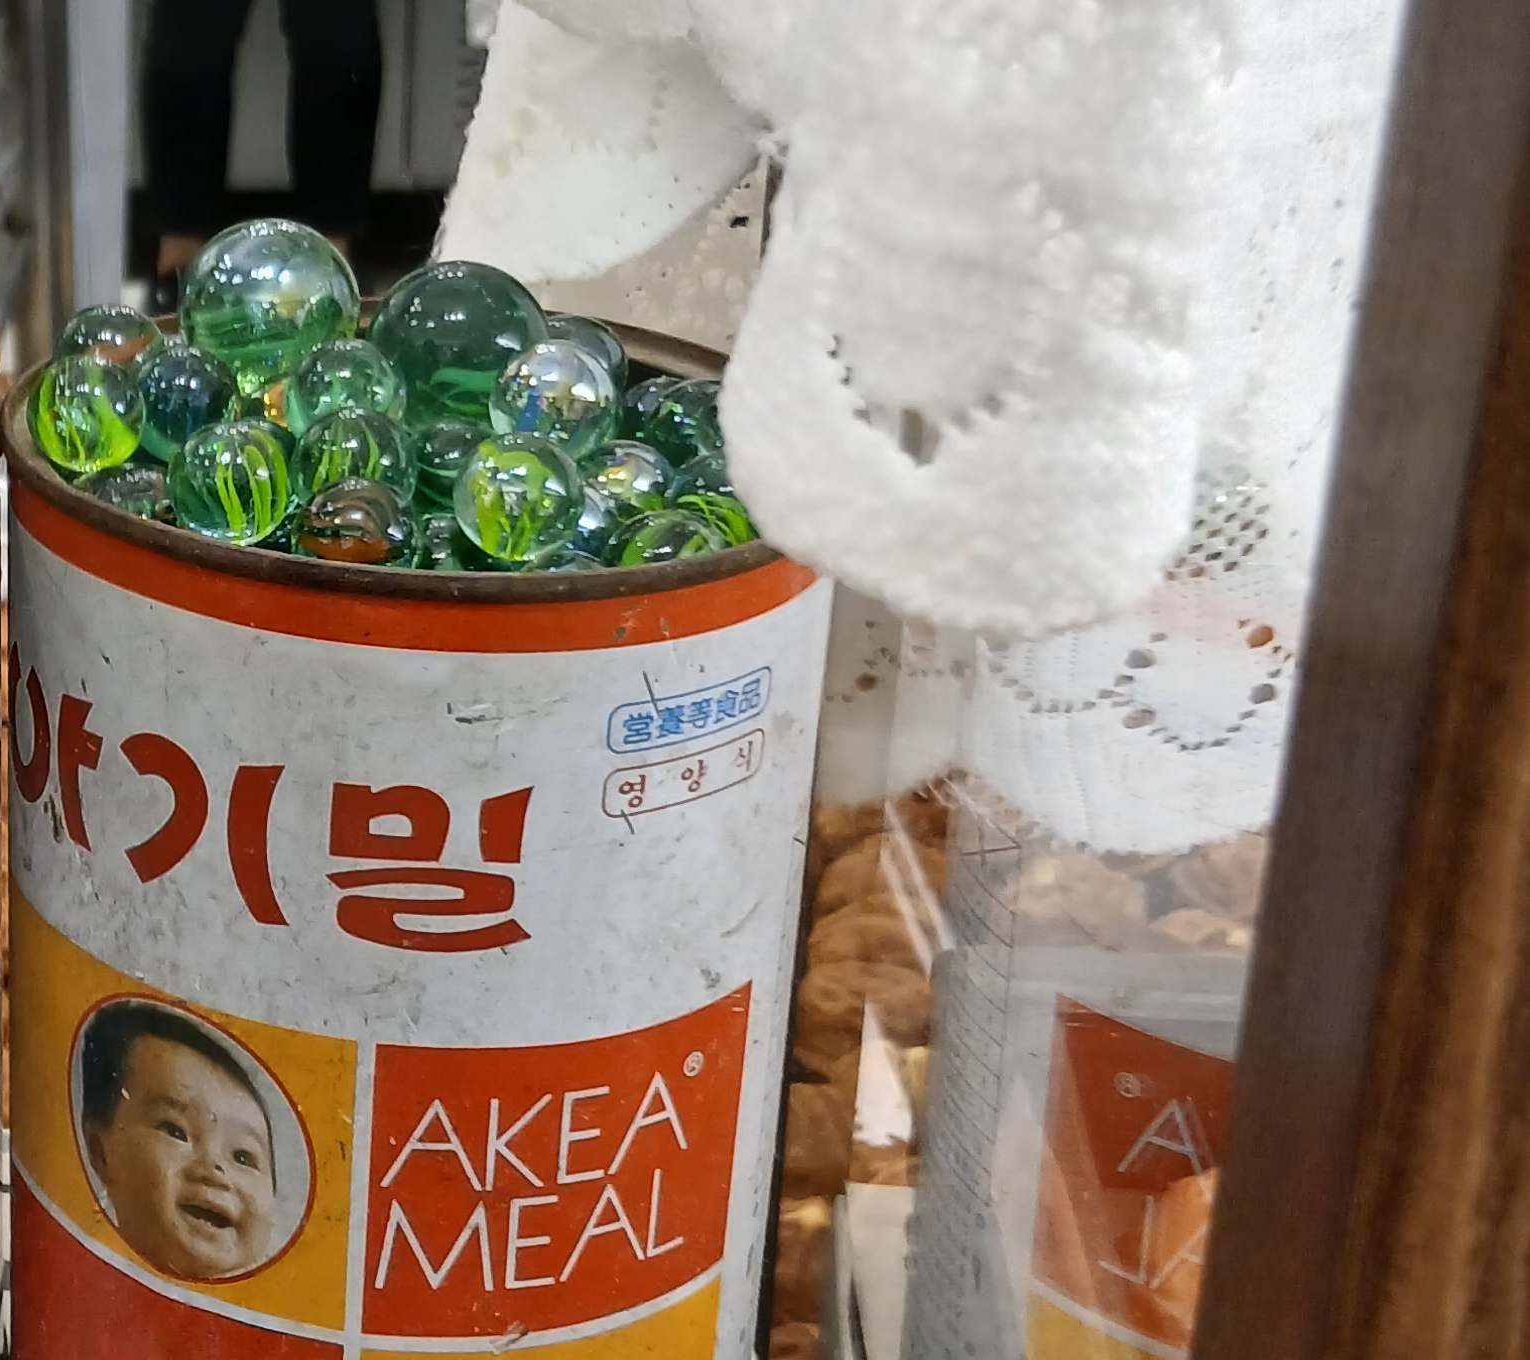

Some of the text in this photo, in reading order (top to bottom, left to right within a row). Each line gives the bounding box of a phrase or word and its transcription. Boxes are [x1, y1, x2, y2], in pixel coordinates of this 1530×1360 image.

[10, 640, 535, 953] 아기밀
[379, 1071, 688, 1191] AKEA
[374, 1168, 685, 1291] MEAL
